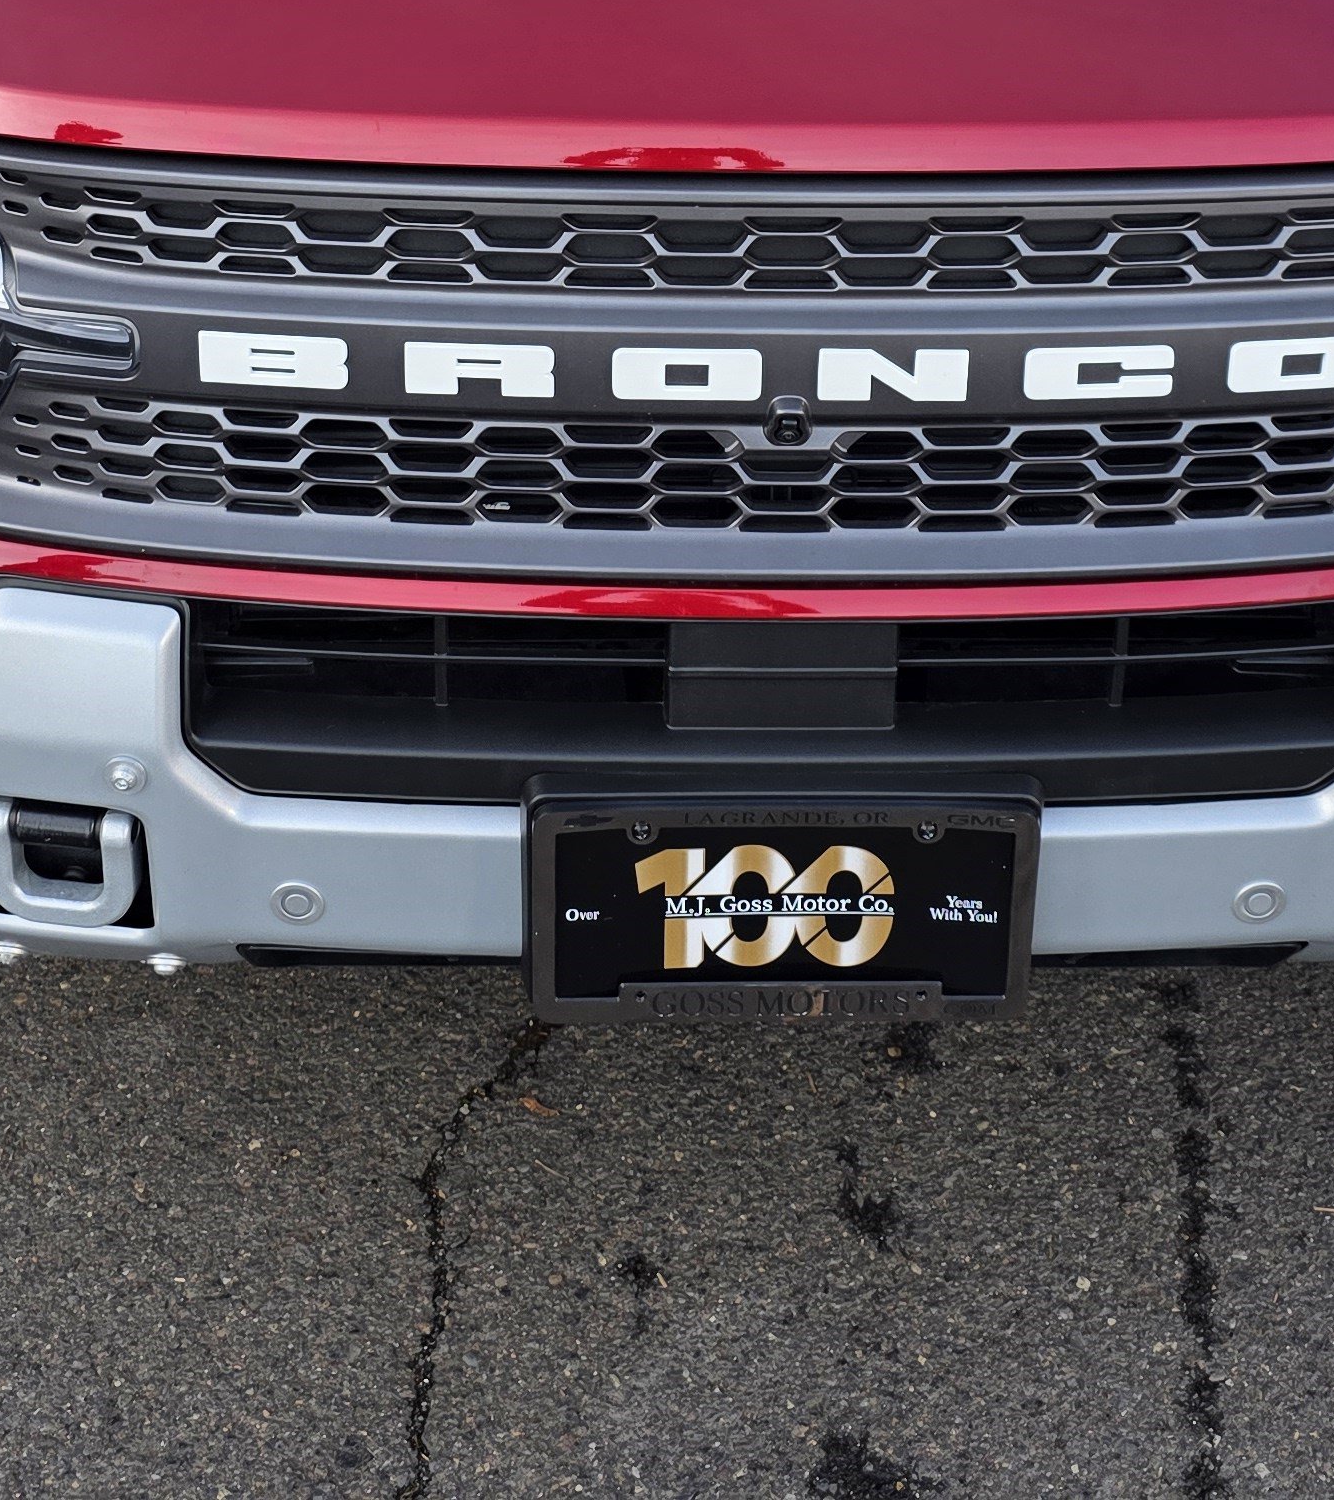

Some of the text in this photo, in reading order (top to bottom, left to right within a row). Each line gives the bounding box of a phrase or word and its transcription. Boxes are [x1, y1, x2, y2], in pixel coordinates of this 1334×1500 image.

[853, 811, 890, 825] OR
[946, 814, 1015, 829] GMC
[634, 844, 895, 970] 100
[665, 894, 895, 917] M.J. Goss Motor Co.
[946, 895, 983, 909] Years
[565, 908, 600, 921] Over
[929, 907, 998, 924] With You!
[652, 988, 910, 1017] GOSS MOTORS
